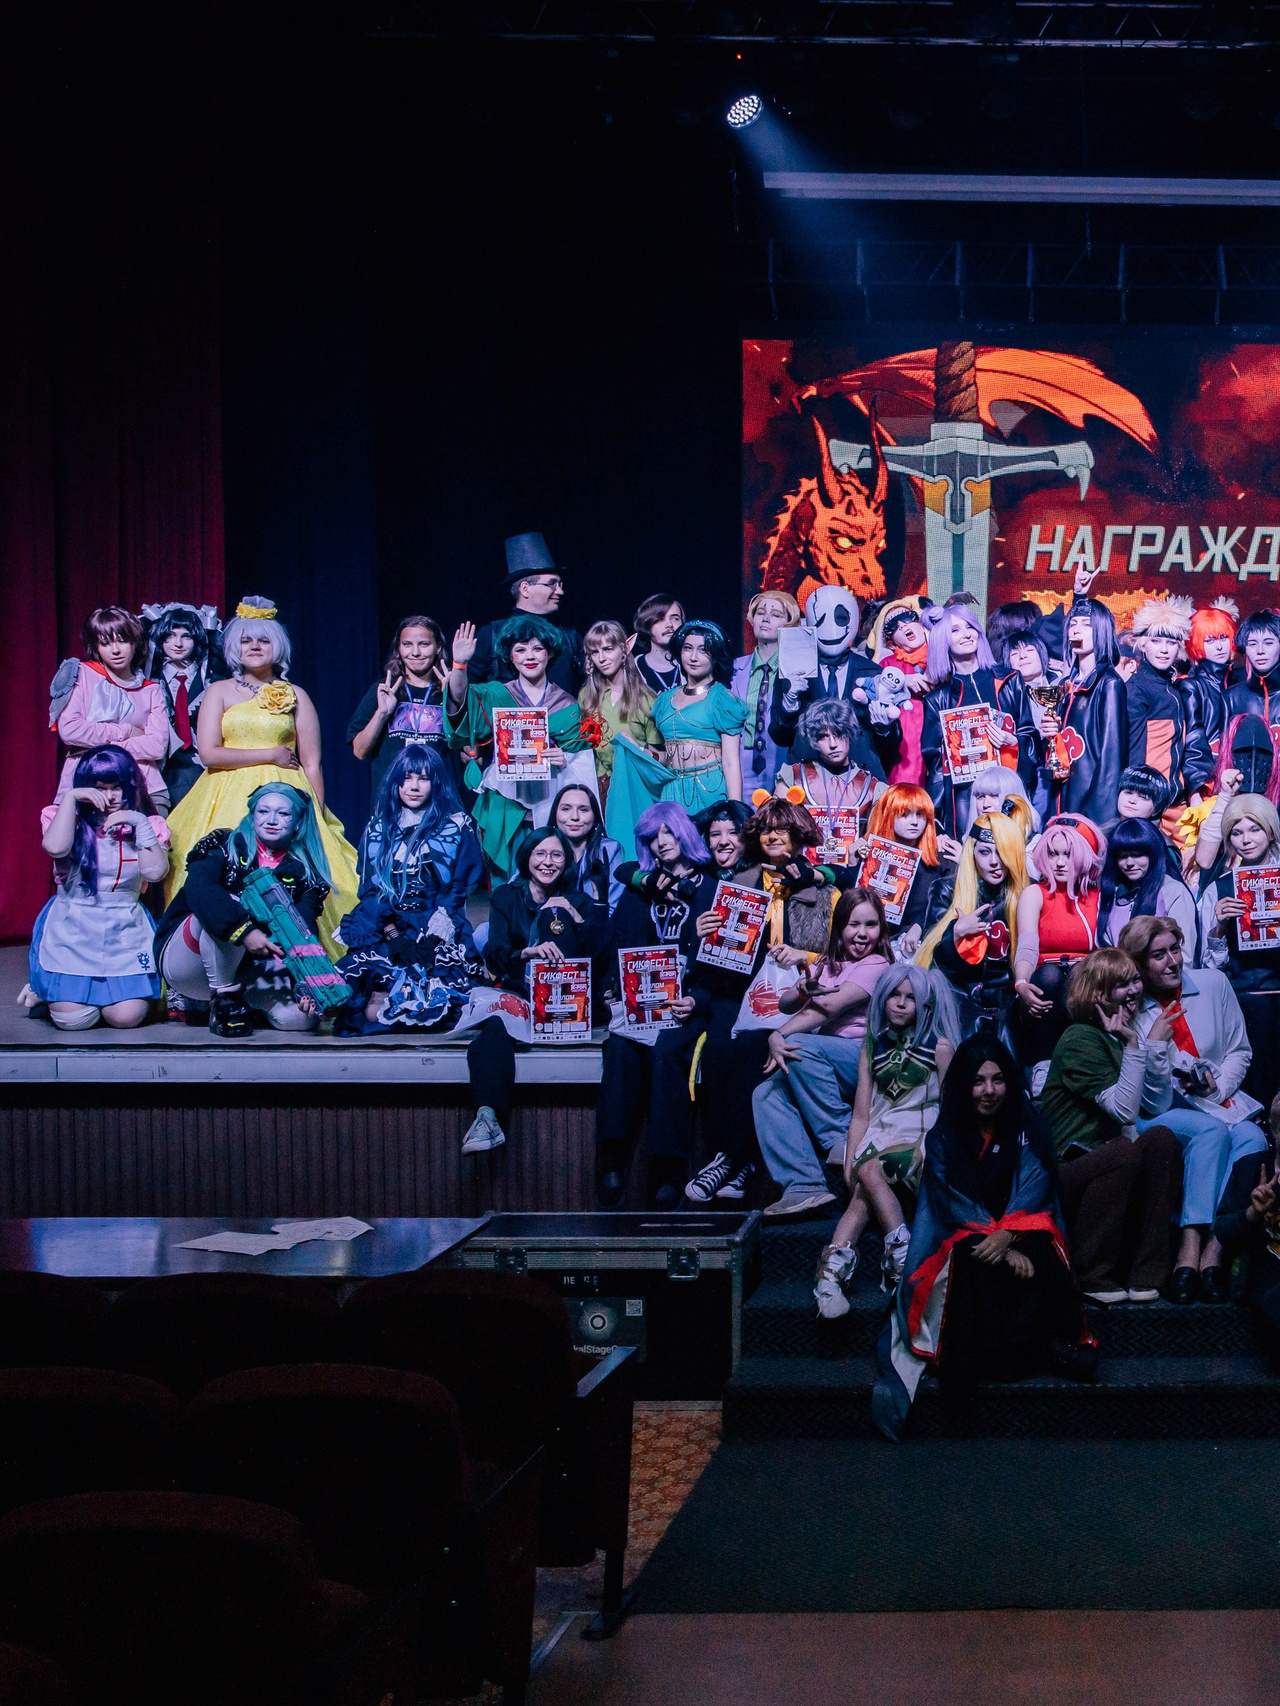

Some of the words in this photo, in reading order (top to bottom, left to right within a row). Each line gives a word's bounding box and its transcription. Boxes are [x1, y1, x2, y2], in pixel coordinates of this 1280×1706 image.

[510, 739, 535, 747] ДЛОМ
[811, 815, 848, 824] ГИКСТ
[1253, 900, 1279, 909] ДЛОМ
[724, 920, 749, 931] ДЛОМ
[538, 971, 579, 981] ГИКФЕСТ
[638, 982, 665, 990] ДЛОМ
[548, 994, 575, 1002] ДЛОМ
